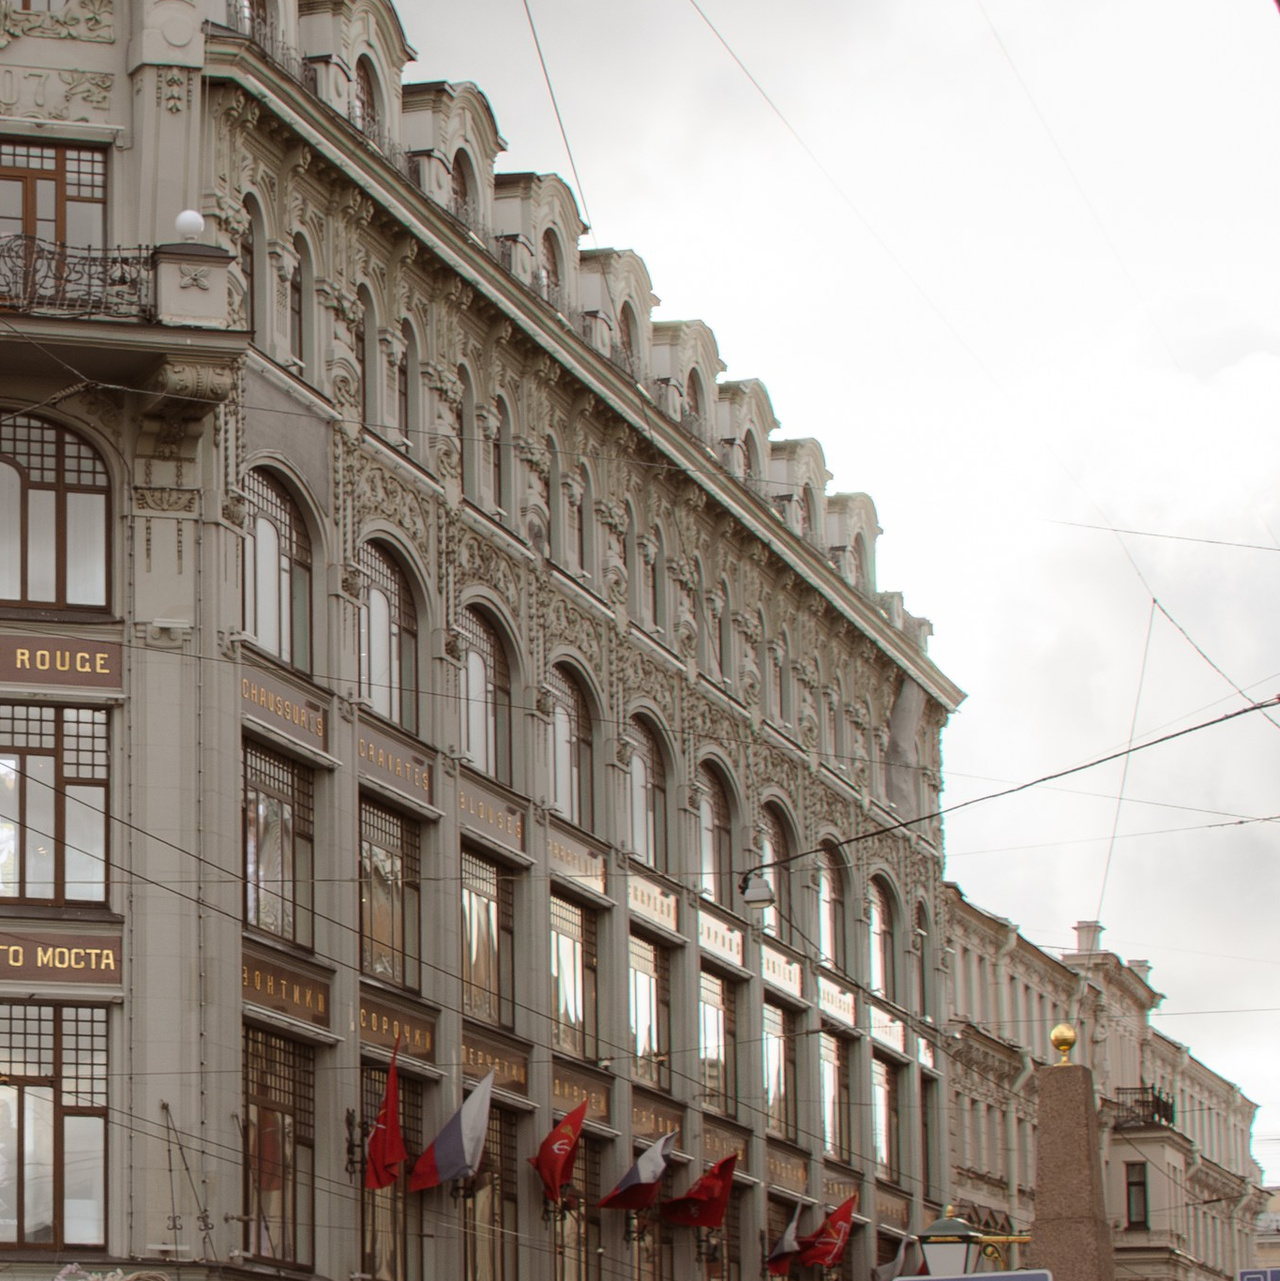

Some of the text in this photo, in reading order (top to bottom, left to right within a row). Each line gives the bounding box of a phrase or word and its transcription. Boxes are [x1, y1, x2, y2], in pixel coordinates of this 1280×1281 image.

[15, 648, 111, 674] ROUGE
[36, 946, 116, 971] МОСТА
[242, 966, 325, 1014] ЗОНТИКИ
[359, 1008, 432, 1050] СОРОЧКИ
